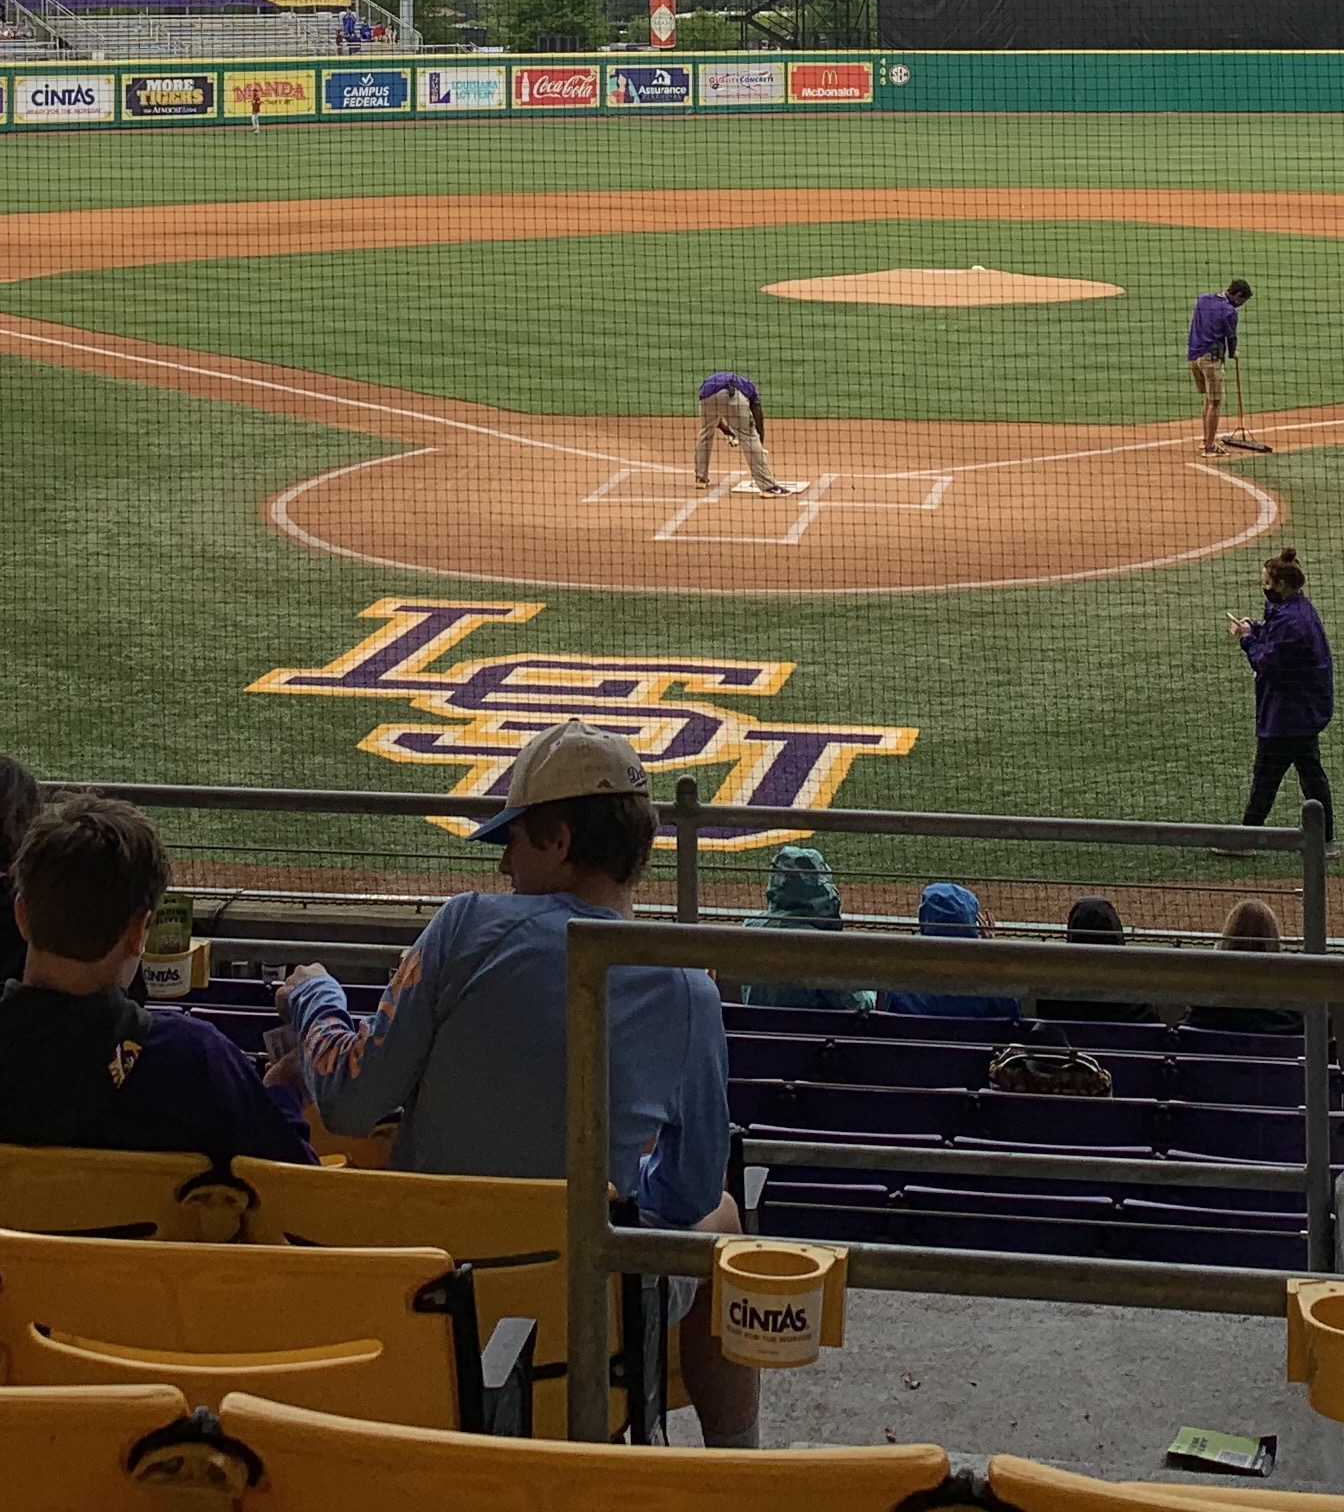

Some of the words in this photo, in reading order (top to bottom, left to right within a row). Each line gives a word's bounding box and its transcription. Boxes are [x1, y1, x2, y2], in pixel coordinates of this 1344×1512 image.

[146, 79, 195, 91] MORE
[638, 86, 687, 95] Assurance
[137, 88, 204, 106] TIGERS
[234, 82, 306, 102] MANDA
[343, 86, 389, 97] CAMPUS
[802, 88, 860, 97] McDonald's
[343, 96, 390, 108] FEDERAL
[245, 597, 918, 851] LSU
